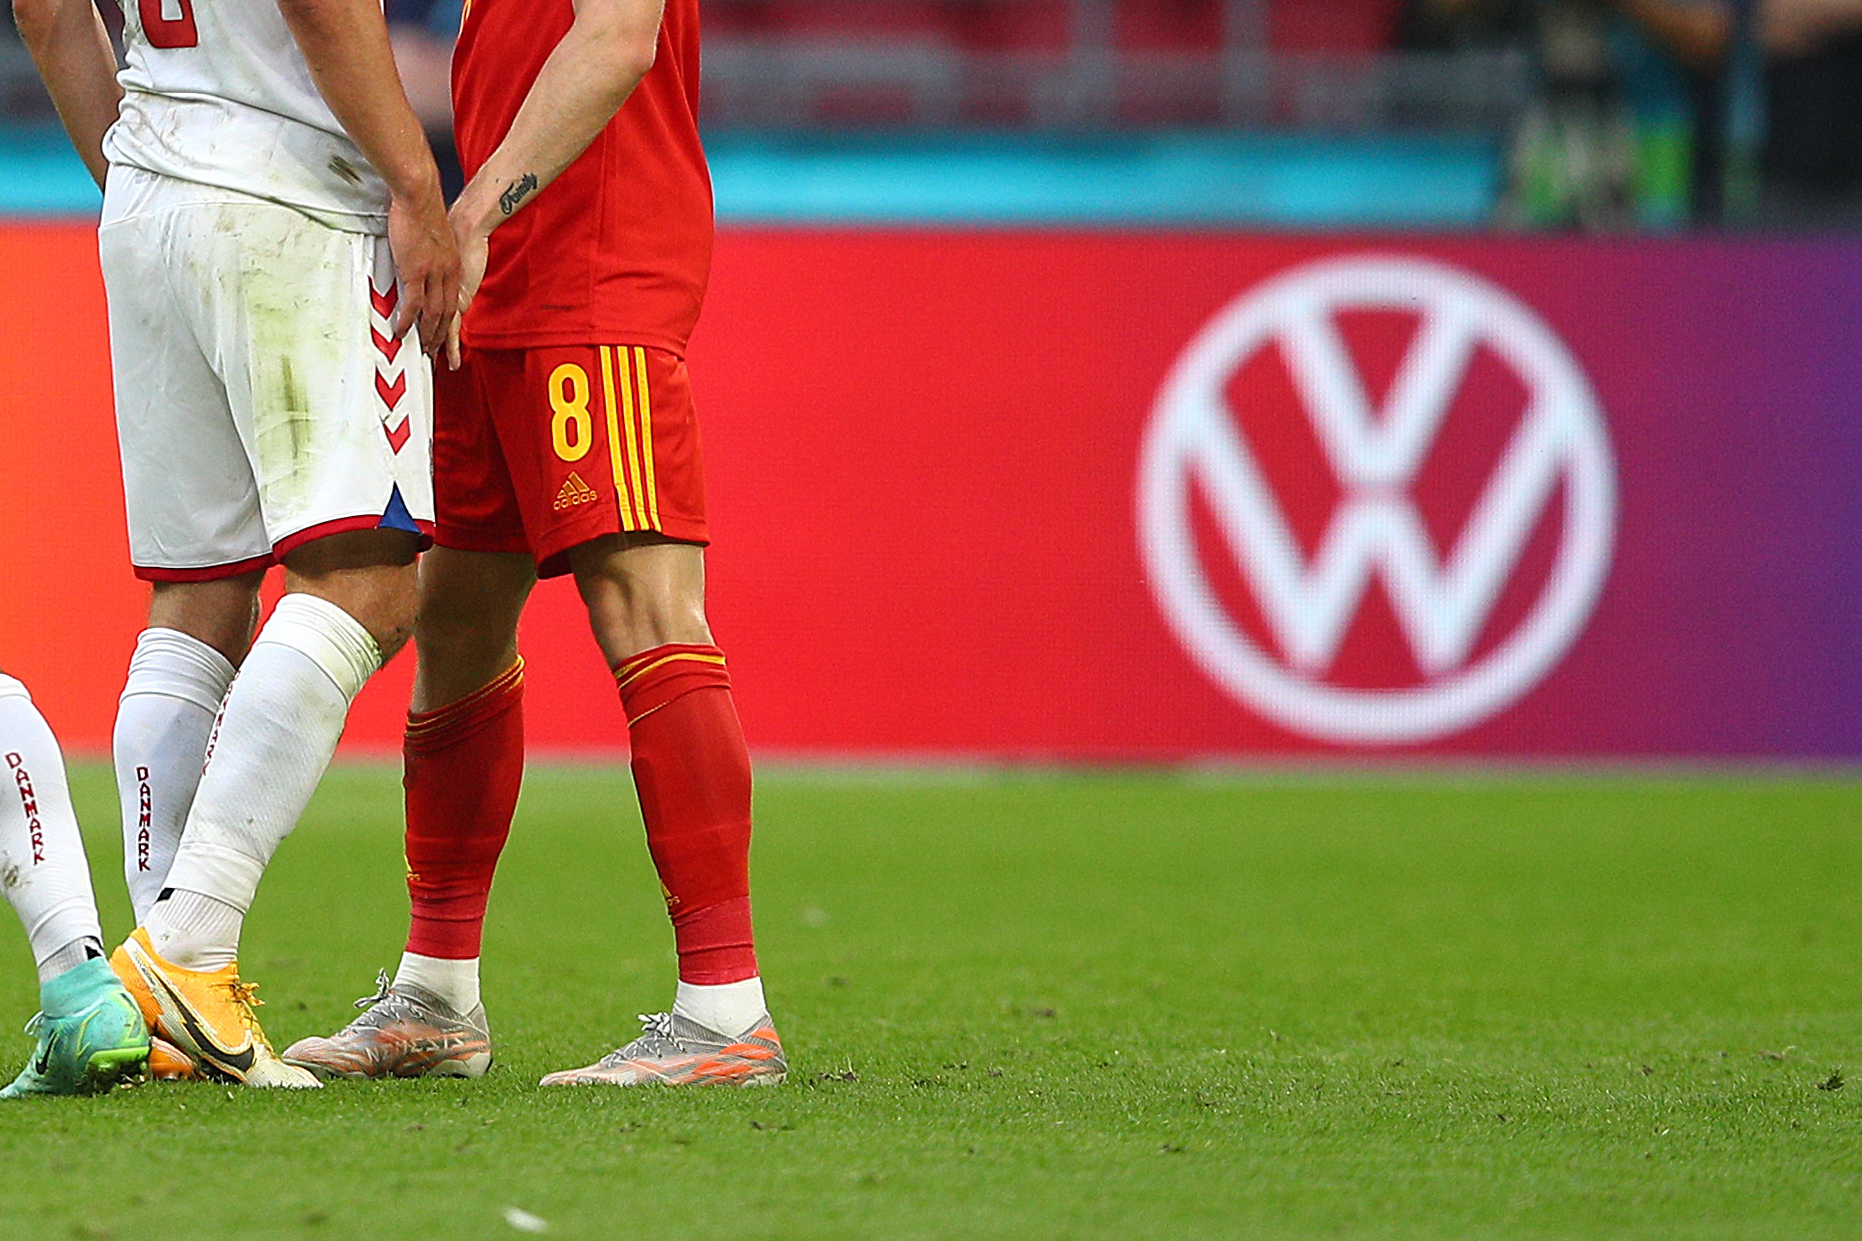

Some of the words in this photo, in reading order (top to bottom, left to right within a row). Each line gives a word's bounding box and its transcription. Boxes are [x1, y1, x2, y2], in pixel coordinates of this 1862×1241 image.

[548, 363, 593, 463] 8
[553, 490, 598, 511] adidas
[5, 752, 45, 867] DANMARK
[136, 766, 151, 871] DANMARK
